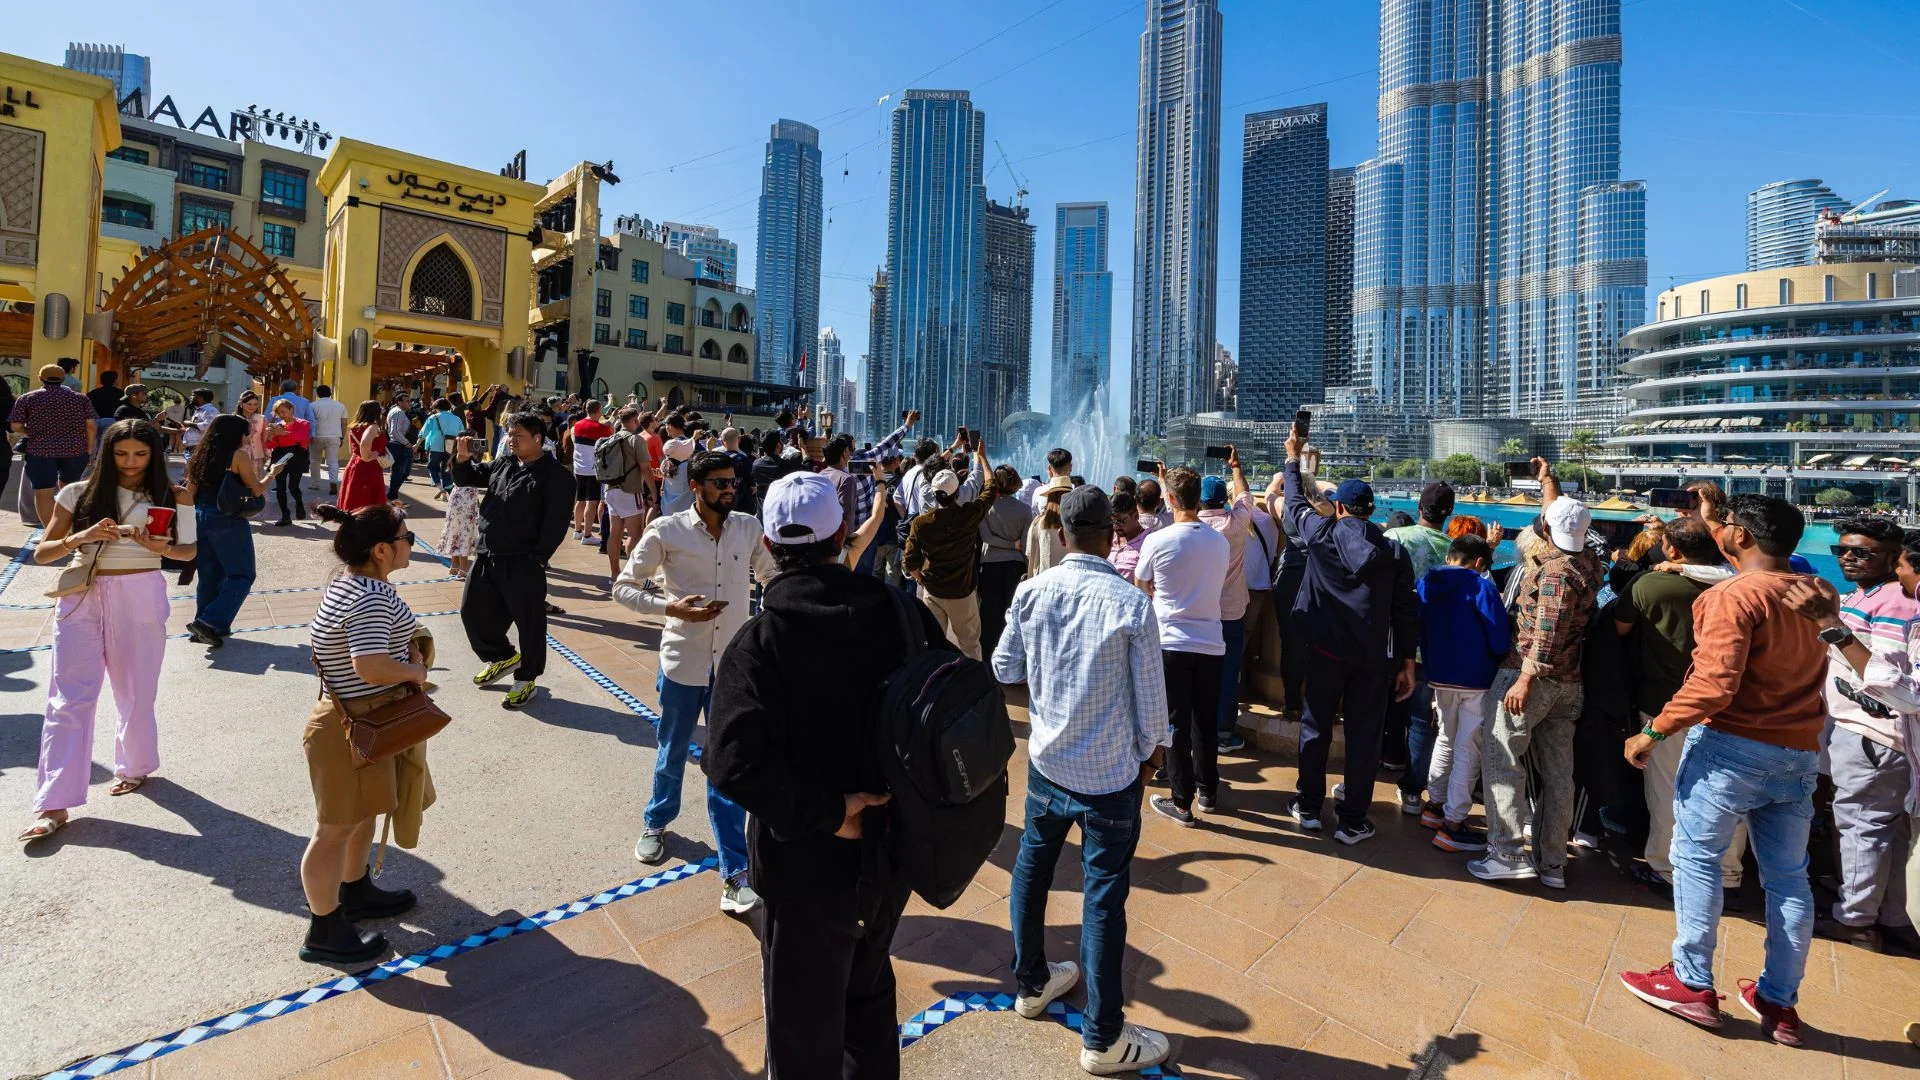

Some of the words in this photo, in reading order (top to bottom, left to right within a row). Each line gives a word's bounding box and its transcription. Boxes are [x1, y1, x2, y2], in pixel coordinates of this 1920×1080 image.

[1272, 112, 1320, 129] EMAAR
[387, 169, 449, 194] مول
[454, 185, 507, 207] دبي
